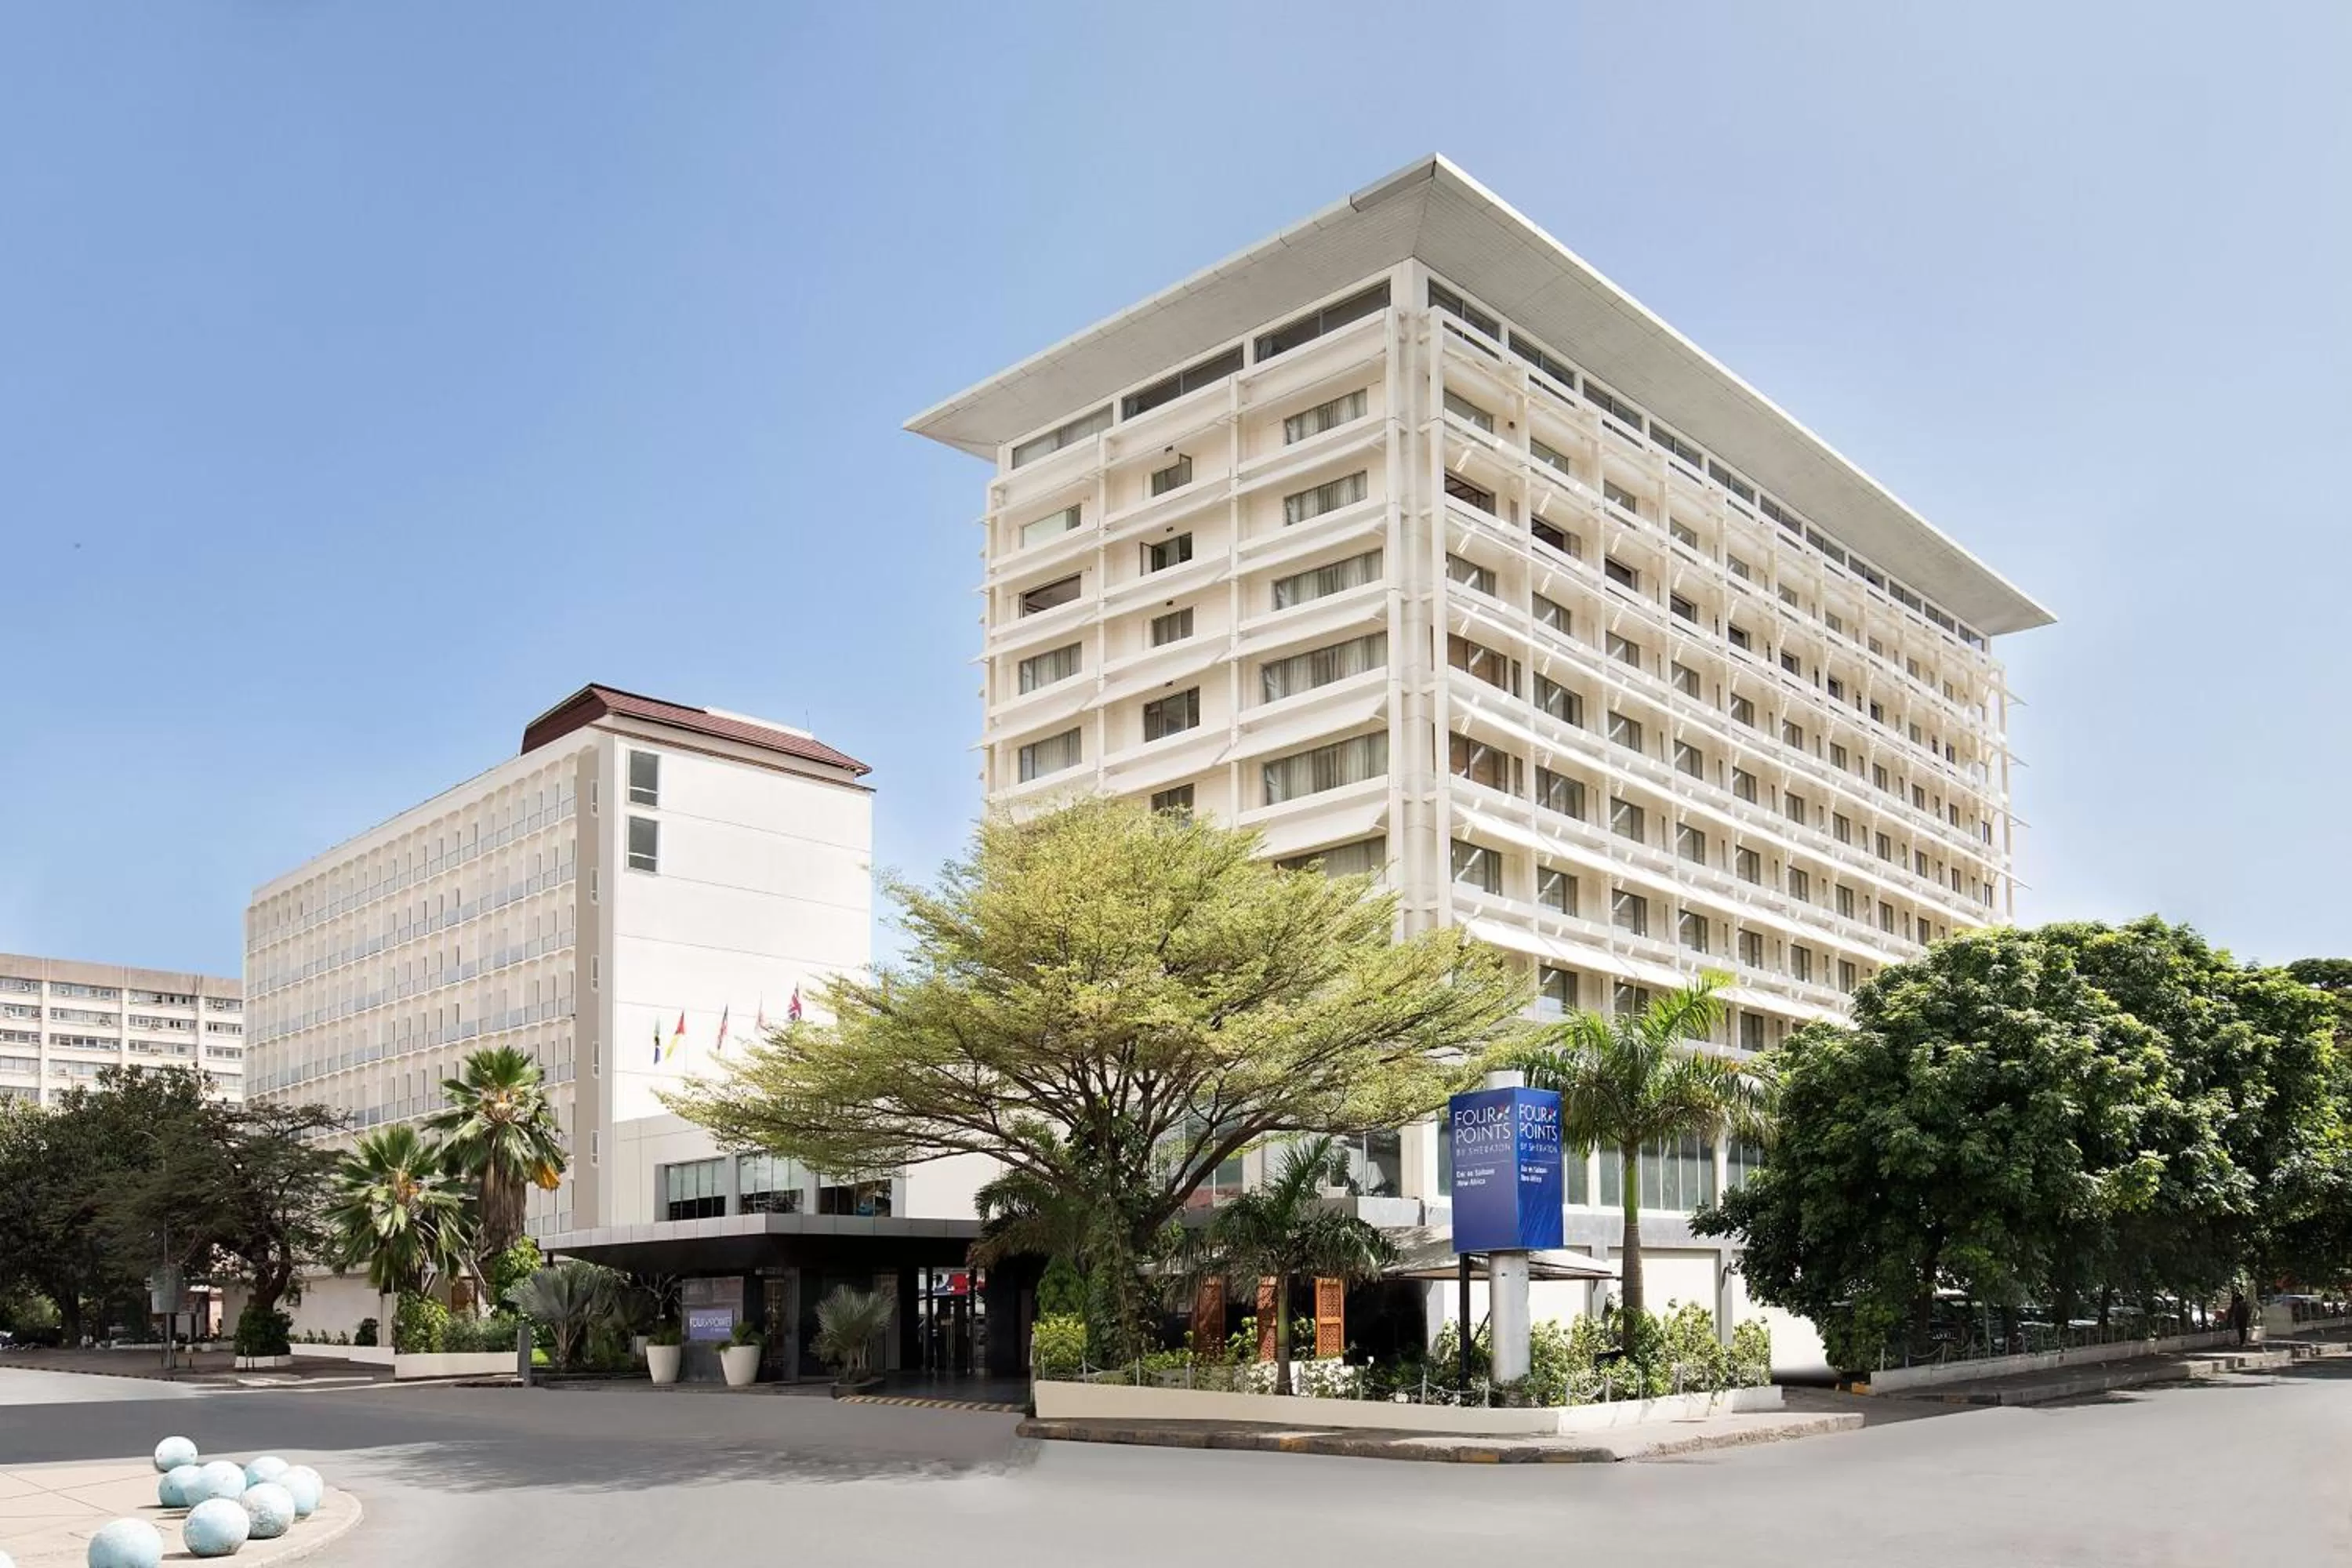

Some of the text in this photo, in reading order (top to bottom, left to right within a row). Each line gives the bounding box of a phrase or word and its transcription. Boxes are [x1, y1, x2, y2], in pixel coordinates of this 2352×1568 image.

[1455, 1106, 1497, 1126] FOUR
[1519, 1103, 1547, 1122] FOUR
[1456, 1123, 1511, 1145] POINTS
[1519, 1123, 1558, 1142] POINTS
[1468, 1144, 1511, 1155] SHERATON
